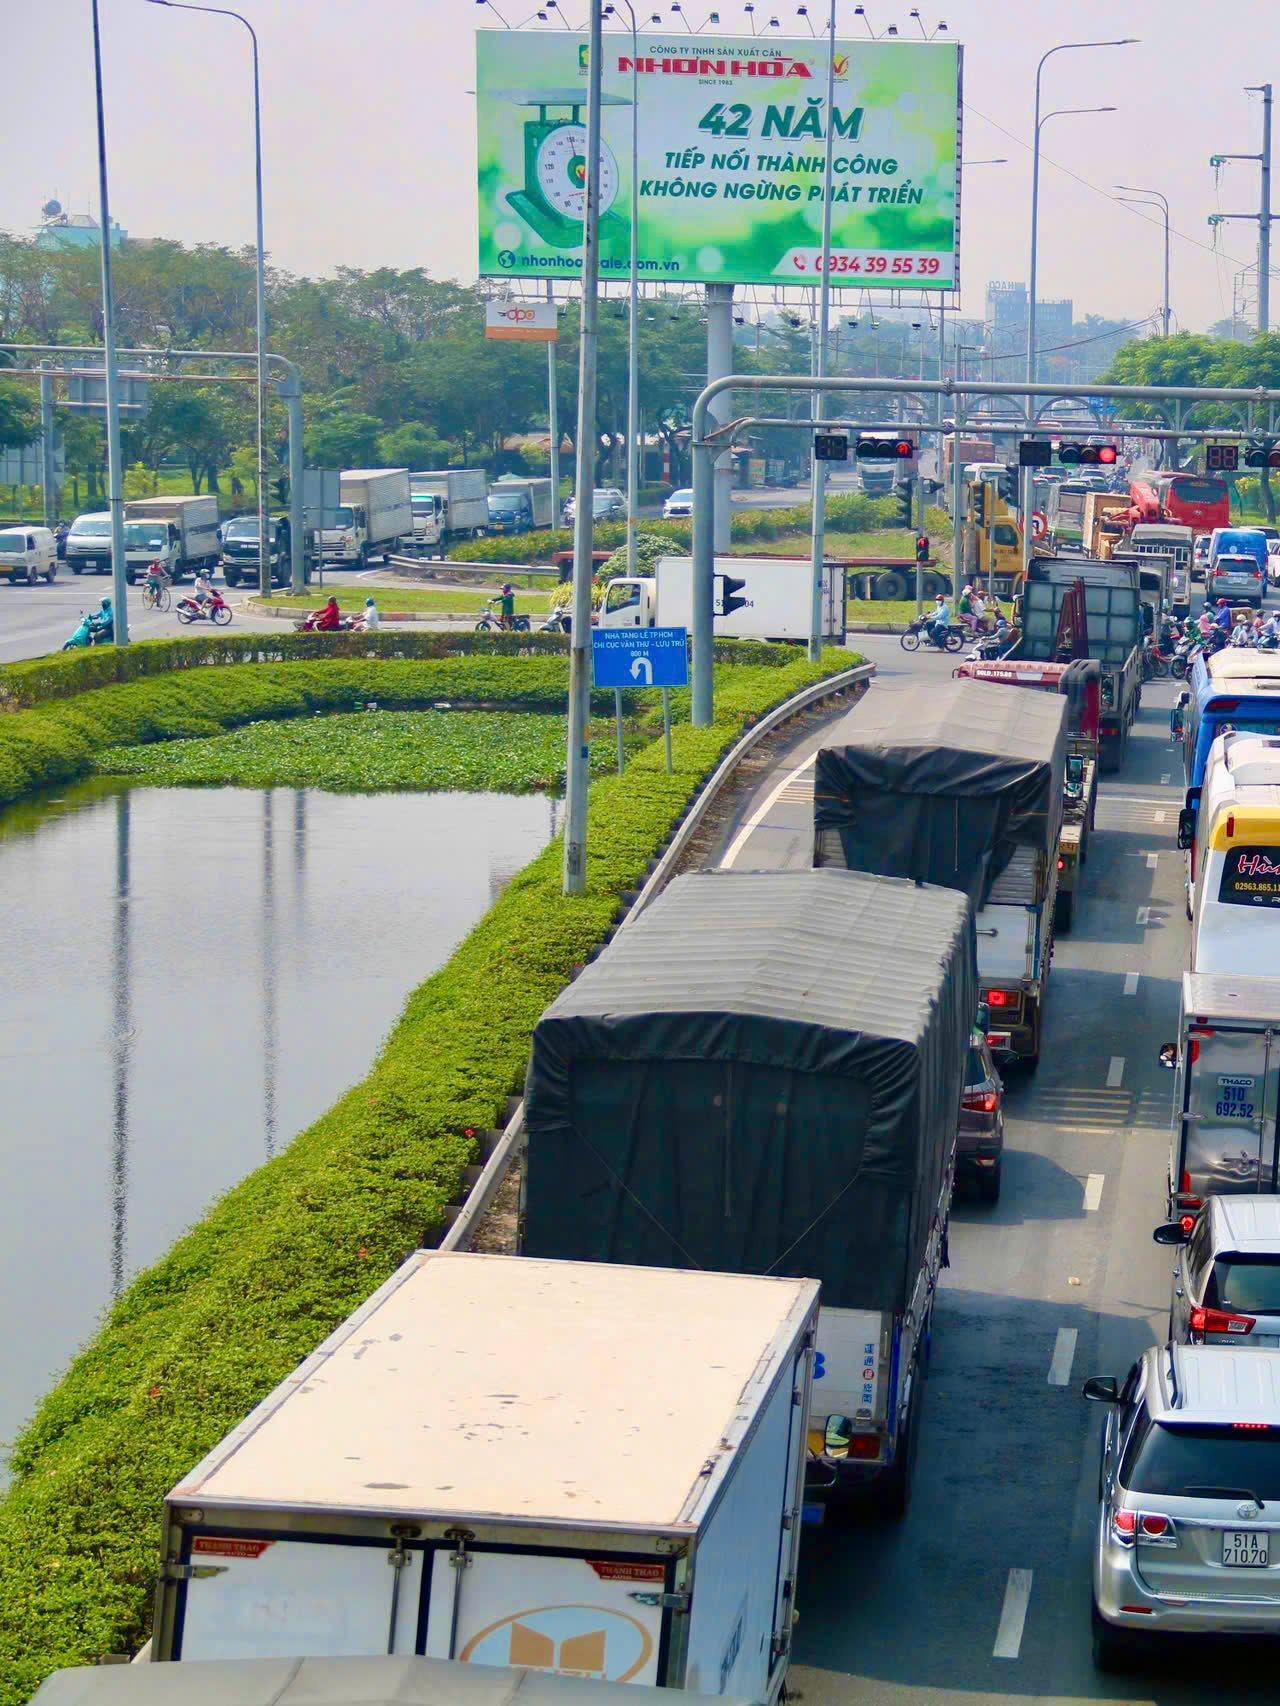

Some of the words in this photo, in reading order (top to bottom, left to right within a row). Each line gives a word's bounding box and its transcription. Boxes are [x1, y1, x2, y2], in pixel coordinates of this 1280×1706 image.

[650, 46, 677, 55] CÔNG
[679, 47, 688, 55] TY
[691, 47, 715, 55] TNHH
[698, 103, 752, 136] 42
[760, 97, 864, 139] NĂM
[665, 146, 705, 169] TIẾP
[711, 147, 750, 170] NỐI
[756, 151, 826, 173] THÀNH
[833, 153, 898, 175] CÔNG
[640, 176, 717, 198] KHÔNG
[724, 179, 801, 201] NGỪNG
[868, 179, 923, 205] TRIỂN
[865, 257, 887, 273] 39
[891, 258, 913, 273] 55
[917, 258, 940, 274] 39
[1216, 1102, 1254, 1118] 692.52
[1234, 1533, 1258, 1548] 51A
[1224, 1548, 1267, 1563] 710.70
